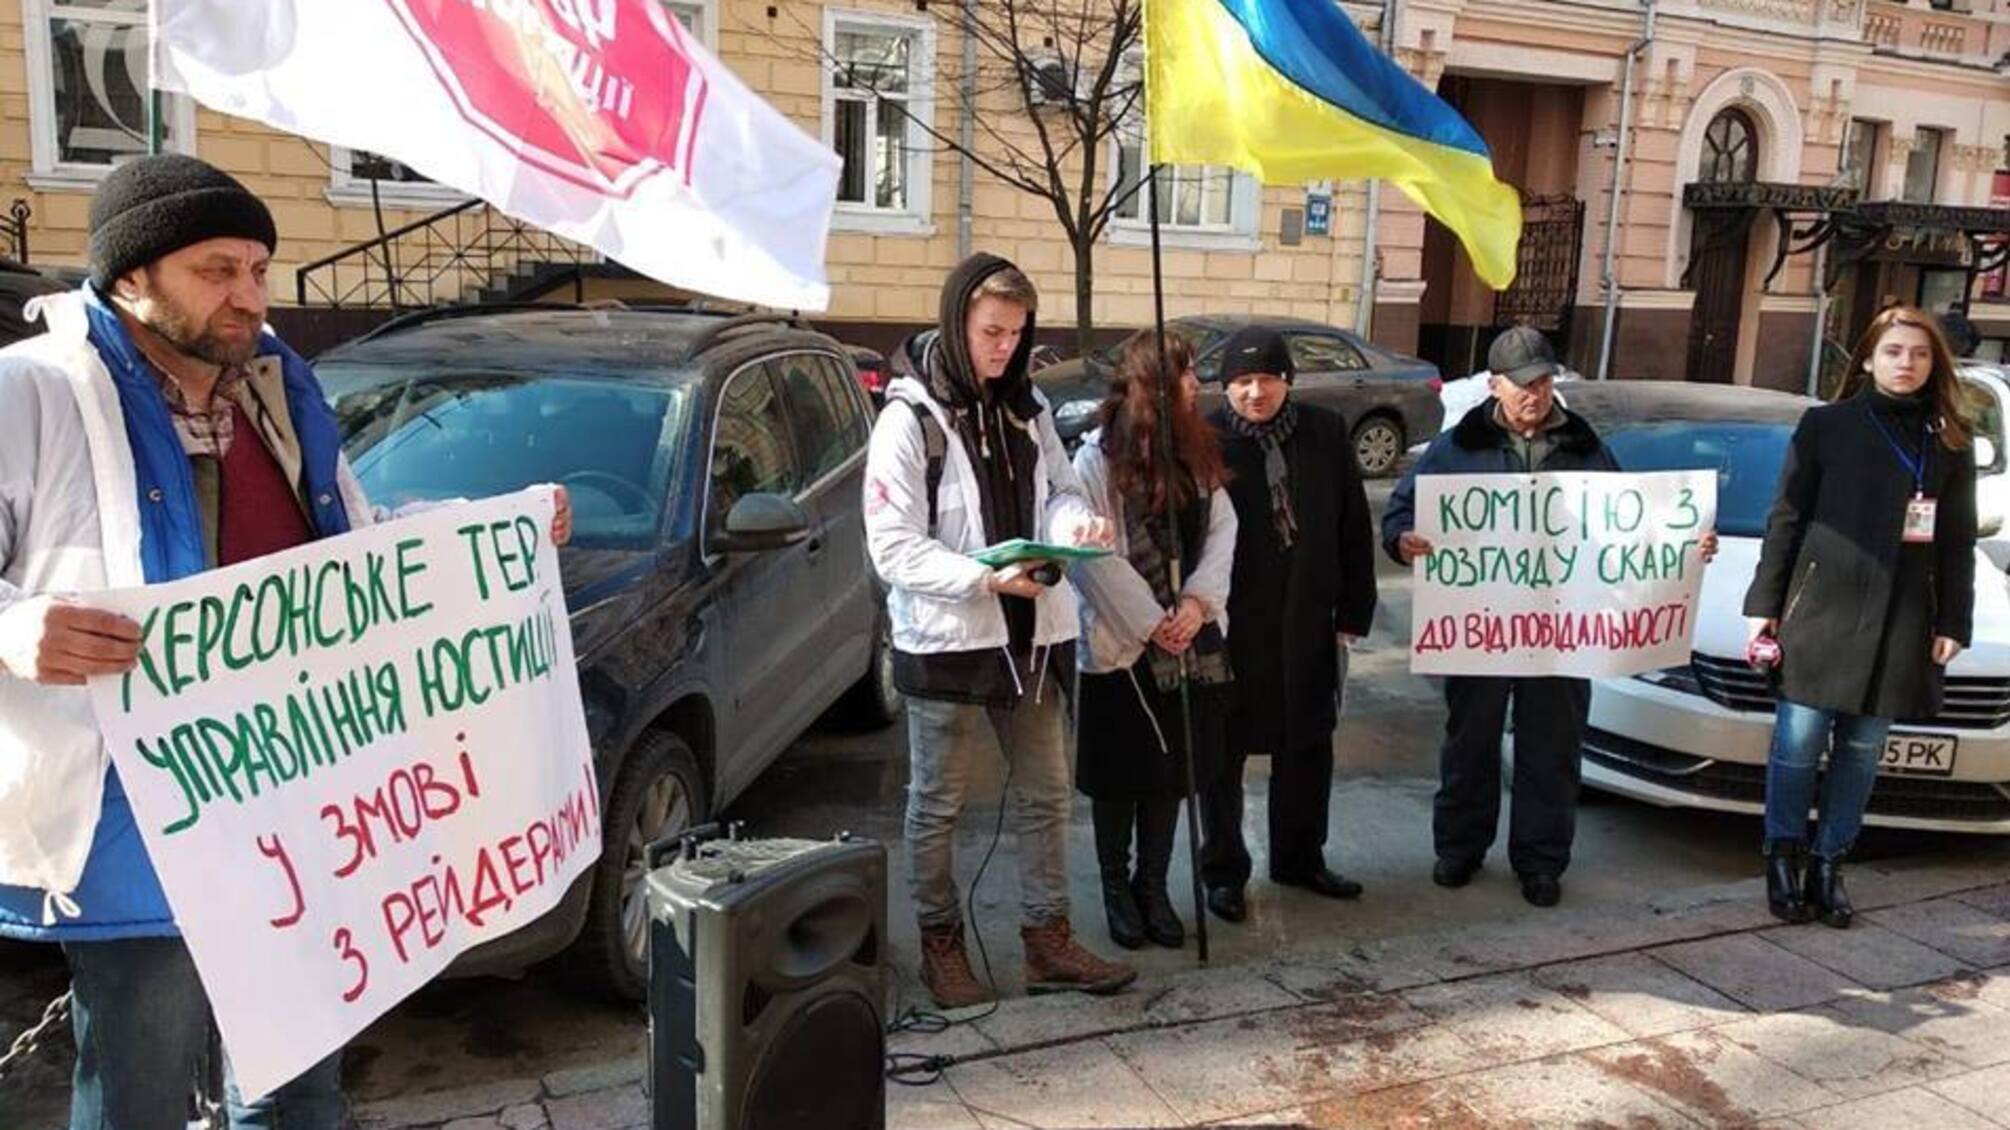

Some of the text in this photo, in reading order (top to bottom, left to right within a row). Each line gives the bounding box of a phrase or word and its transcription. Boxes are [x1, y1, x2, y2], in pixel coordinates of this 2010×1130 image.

[1666, 488, 1699, 529] З
[1425, 540, 1699, 589] РОЗГЛЯДУ СКАРГ
[121, 538, 433, 712] ХЕРСОНСЬКЕ
[1415, 594, 1689, 653] ДО ВІДПОВІДАЛЬНОСТІ
[136, 671, 406, 835] УПРАВЛІННЯ
[1906, 742, 1945, 767] PK
[256, 732, 479, 928] У ЗМОВІ
[334, 926, 368, 1002] З
